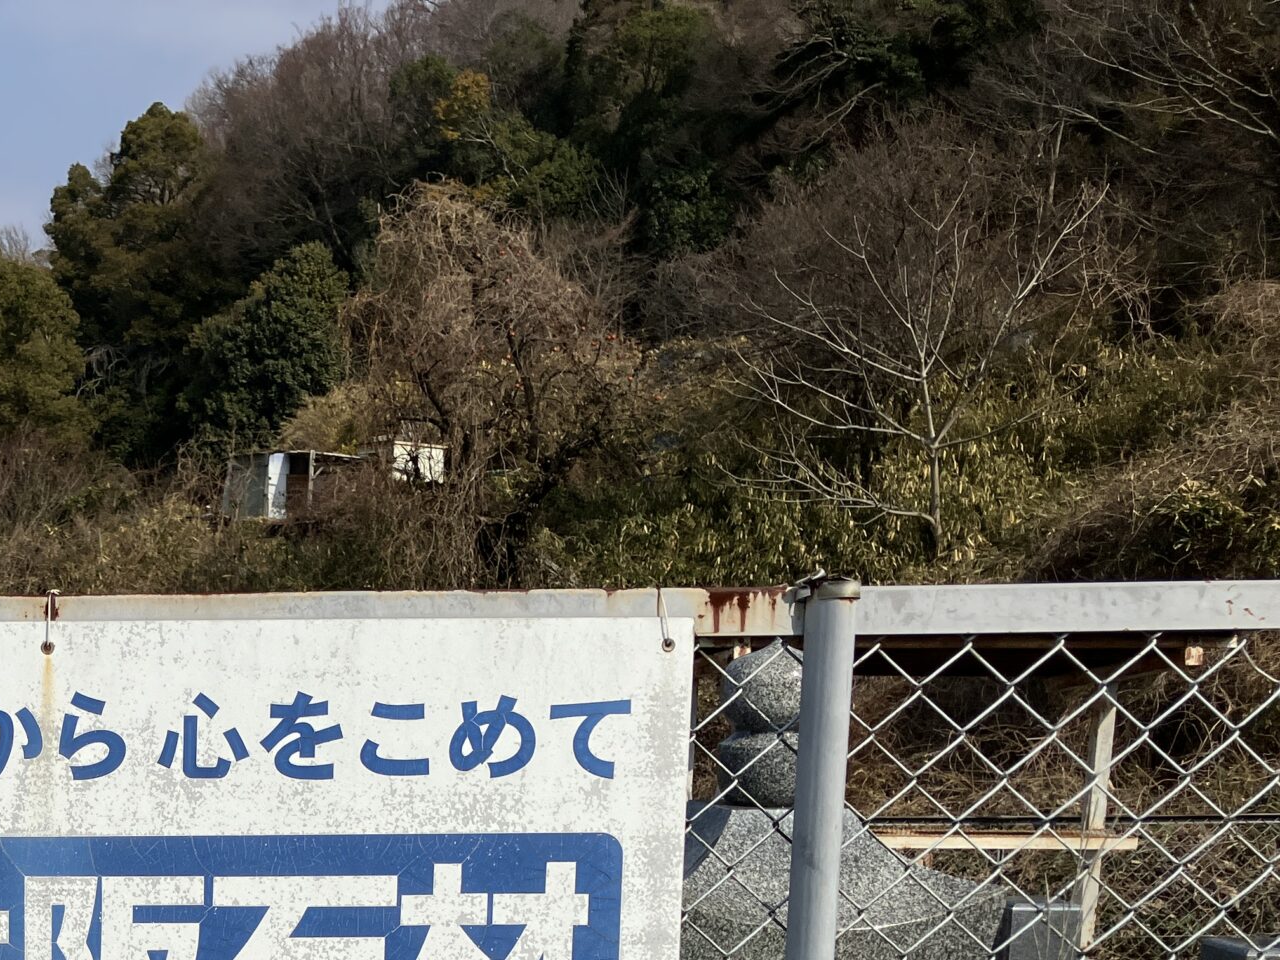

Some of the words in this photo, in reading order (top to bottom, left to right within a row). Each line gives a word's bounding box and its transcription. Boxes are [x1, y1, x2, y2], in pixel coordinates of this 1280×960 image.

[157, 690, 632, 780] 心をこめて
